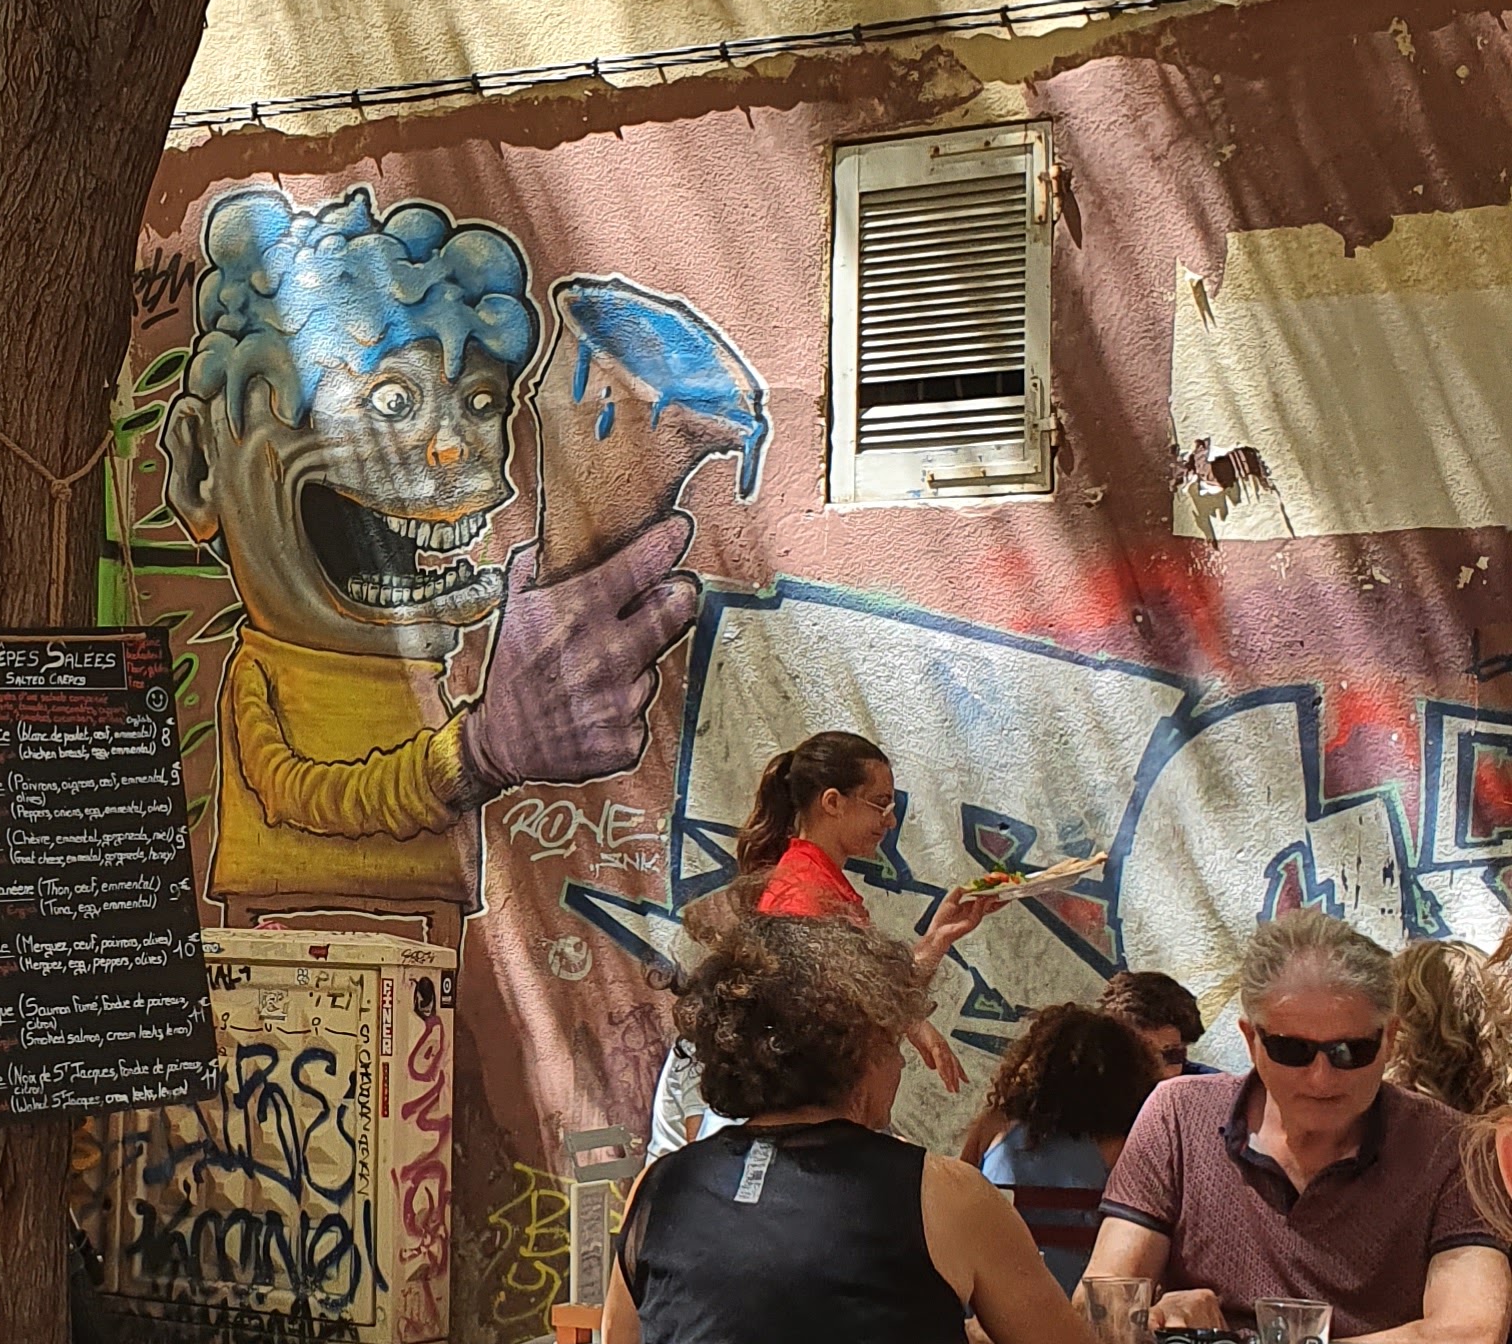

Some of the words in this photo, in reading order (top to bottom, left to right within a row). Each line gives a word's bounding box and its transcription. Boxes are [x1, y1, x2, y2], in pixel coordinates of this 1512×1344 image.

[40, 642, 116, 673] SALÉES
[6, 672, 45, 686] SALTED
[38, 877, 72, 900] (Thon,
[101, 873, 161, 893] emmental)
[40, 898, 77, 920] (Tuna,
[103, 893, 157, 910] emmental)
[16, 933, 72, 959] (Merguez,
[19, 993, 71, 1018] (Saumon
[133, 992, 145, 1008] de
